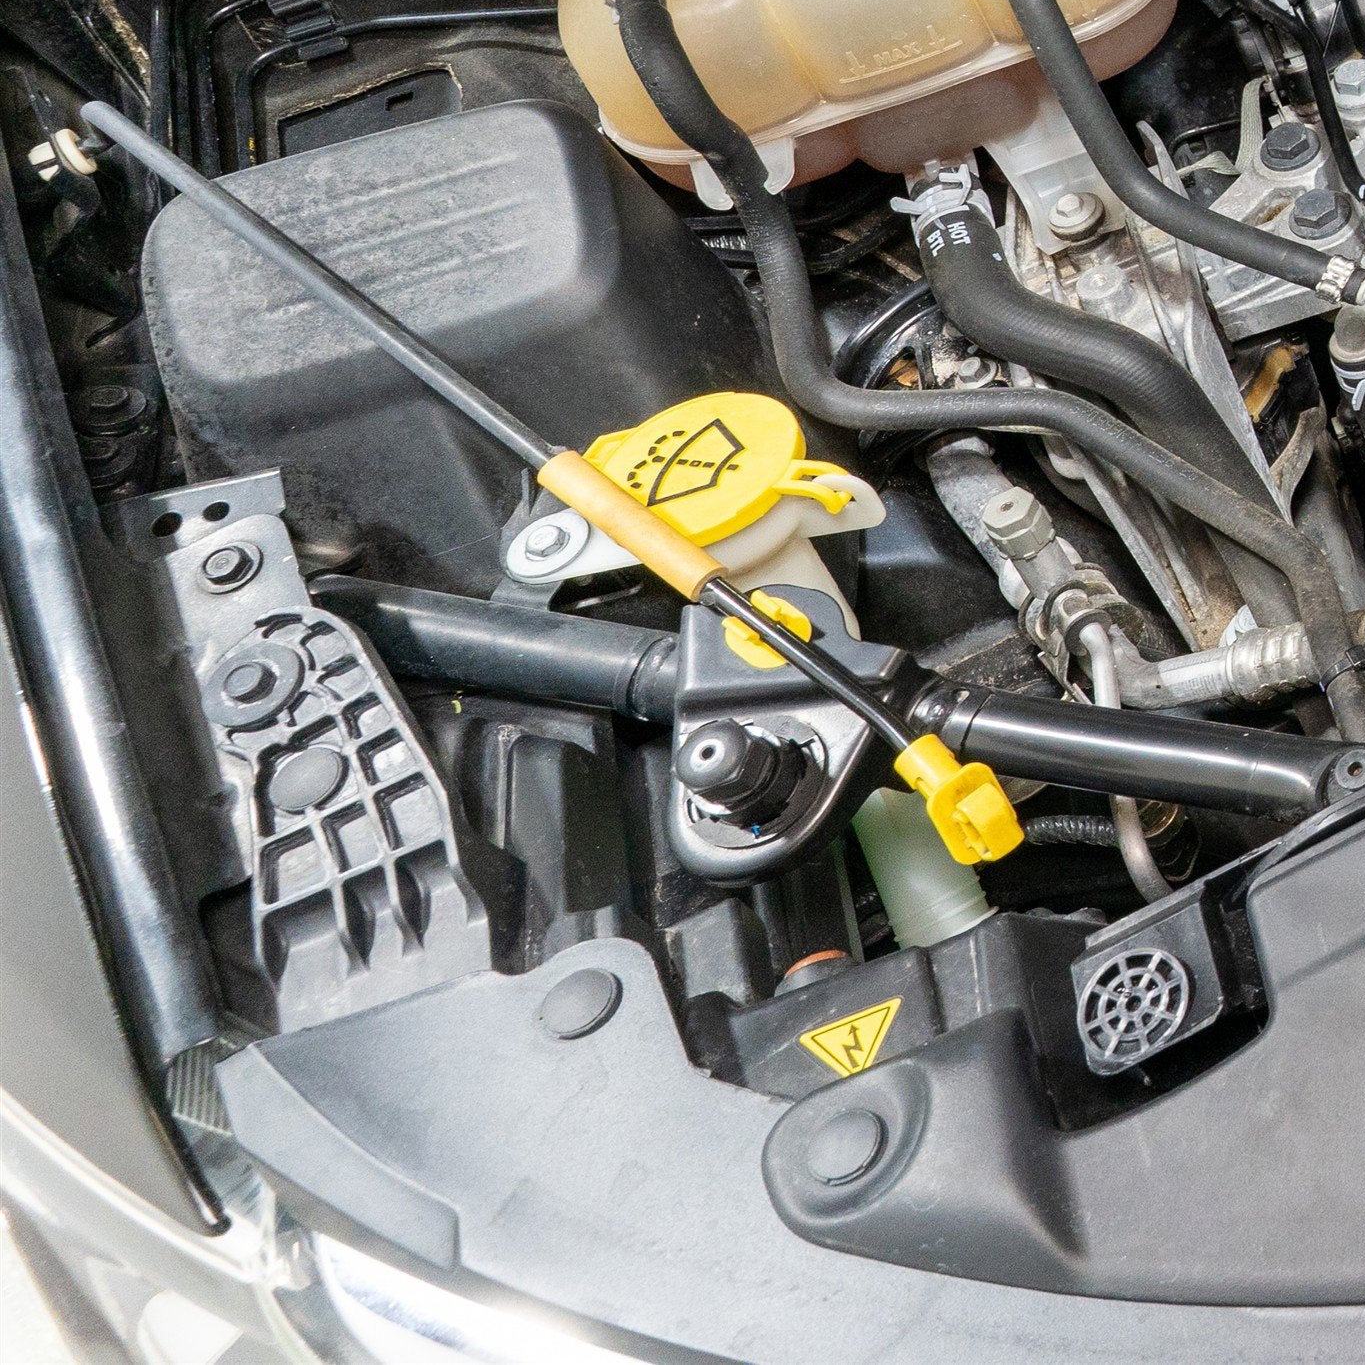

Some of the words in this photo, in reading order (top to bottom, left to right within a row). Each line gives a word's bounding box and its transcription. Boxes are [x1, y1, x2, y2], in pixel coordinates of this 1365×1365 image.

[873, 41, 922, 65] MAX
[927, 229, 945, 257] BTL
[947, 221, 971, 245] HOT
